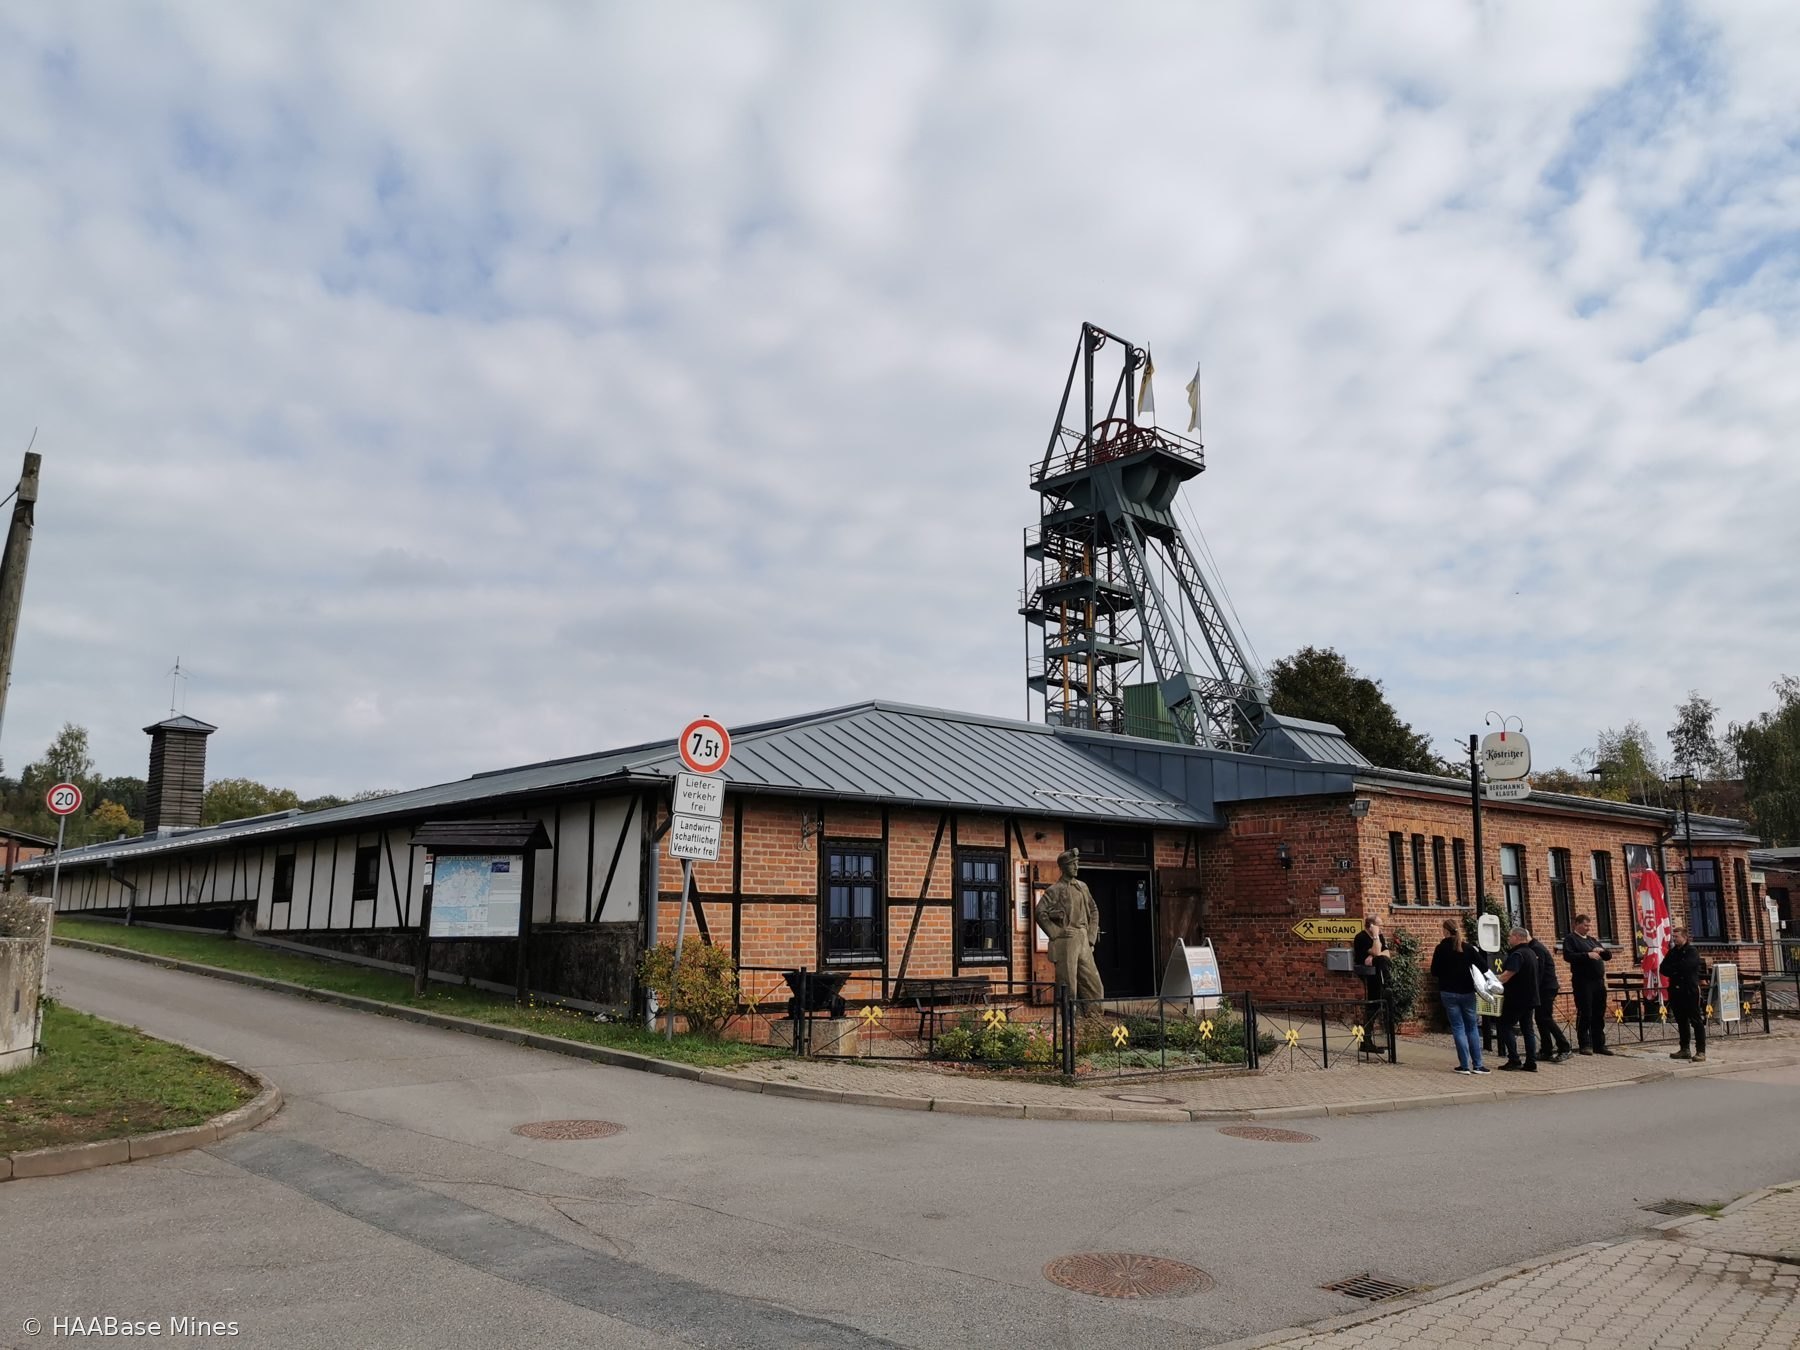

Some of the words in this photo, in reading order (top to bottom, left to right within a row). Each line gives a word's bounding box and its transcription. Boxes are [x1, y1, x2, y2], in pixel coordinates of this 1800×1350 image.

[686, 778, 715, 790] Liefer-
[55, 792, 74, 806] 20
[683, 790, 716, 802] verkehr
[691, 801, 706, 812] frei
[680, 820, 715, 834] Landwirt-
[675, 832, 717, 846] schaftlicher
[673, 843, 701, 855] Verkehr
[703, 847, 715, 857] frei
[1317, 926, 1356, 934] EINGANG
